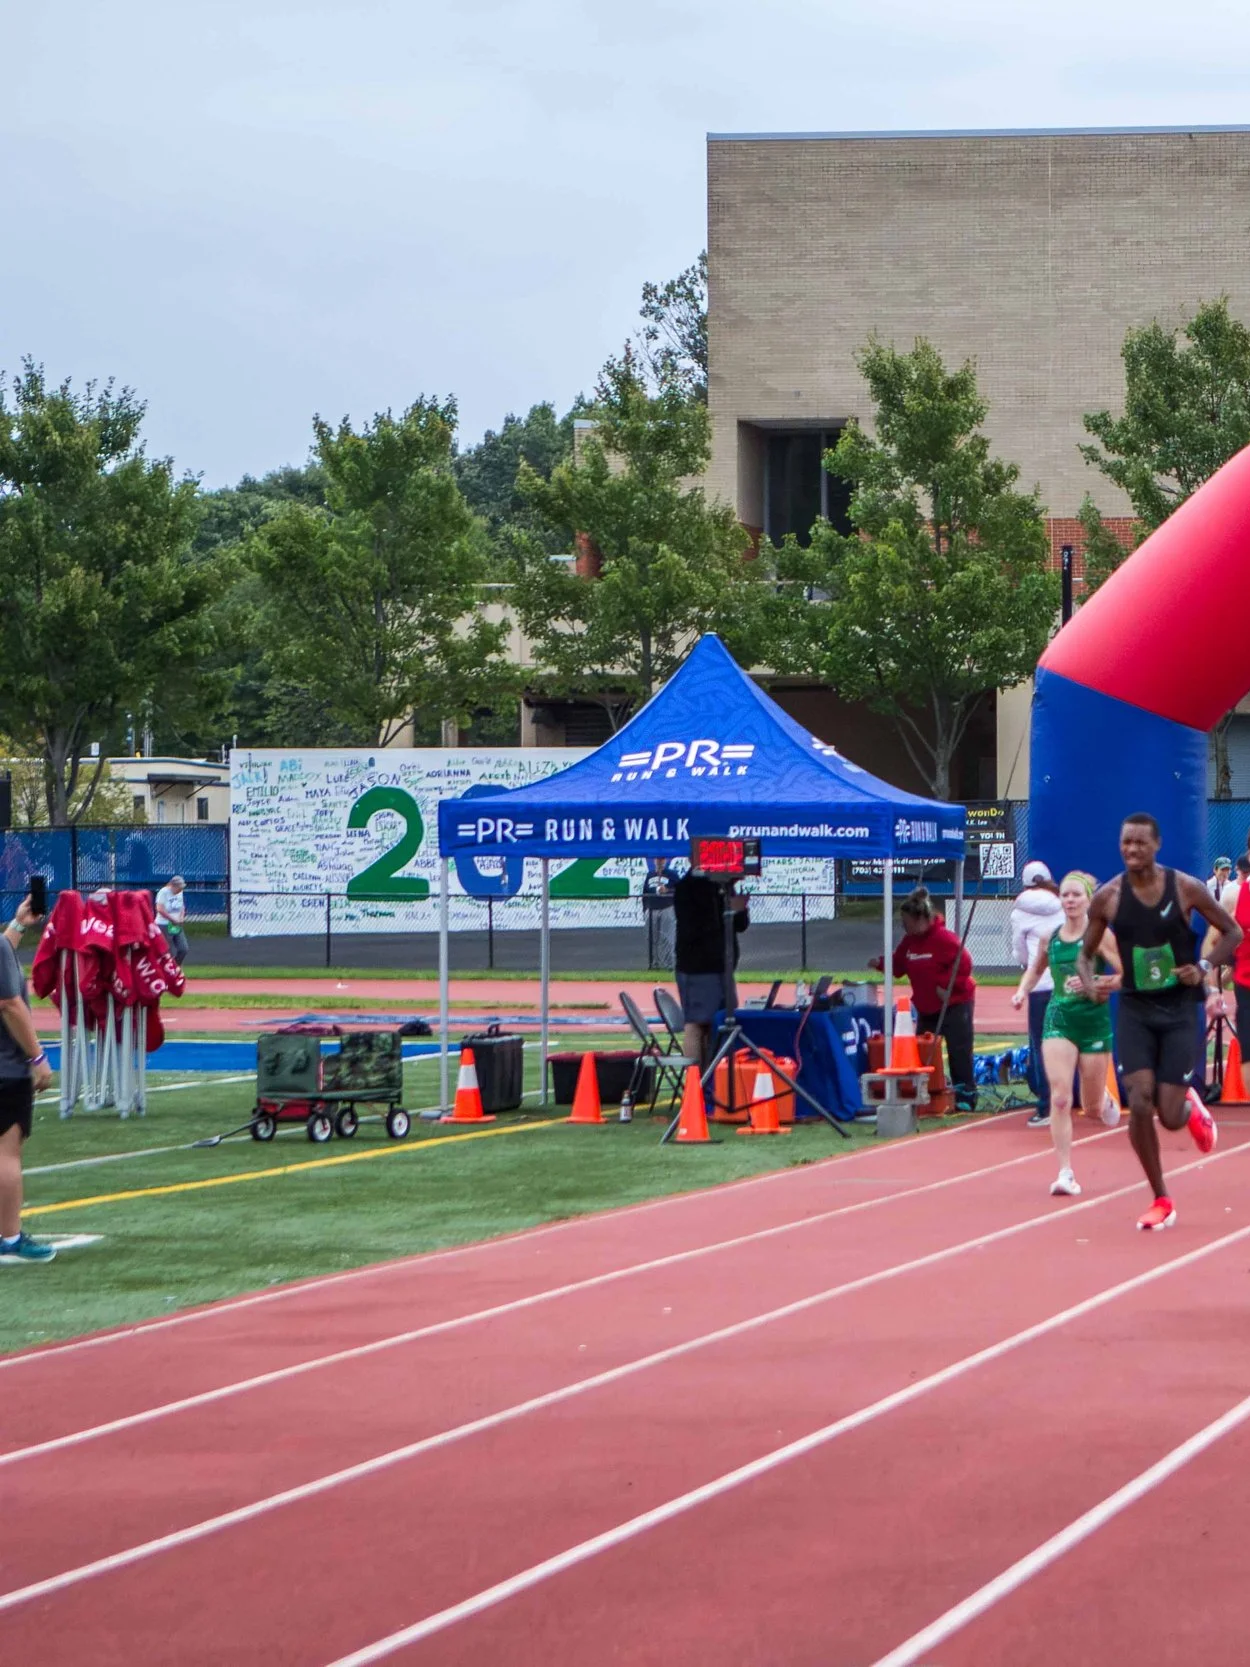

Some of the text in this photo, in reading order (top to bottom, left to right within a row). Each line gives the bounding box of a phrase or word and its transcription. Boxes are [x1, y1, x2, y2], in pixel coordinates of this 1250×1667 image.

[611, 771, 653, 783] RUN
[691, 765, 749, 777] WALK
[349, 772, 401, 799] JASON
[545, 818, 593, 841] RUN
[602, 818, 616, 841] &
[624, 818, 690, 841] WALK
[727, 823, 869, 839] prrunandwalk.com
[1150, 966, 1162, 980] 3
